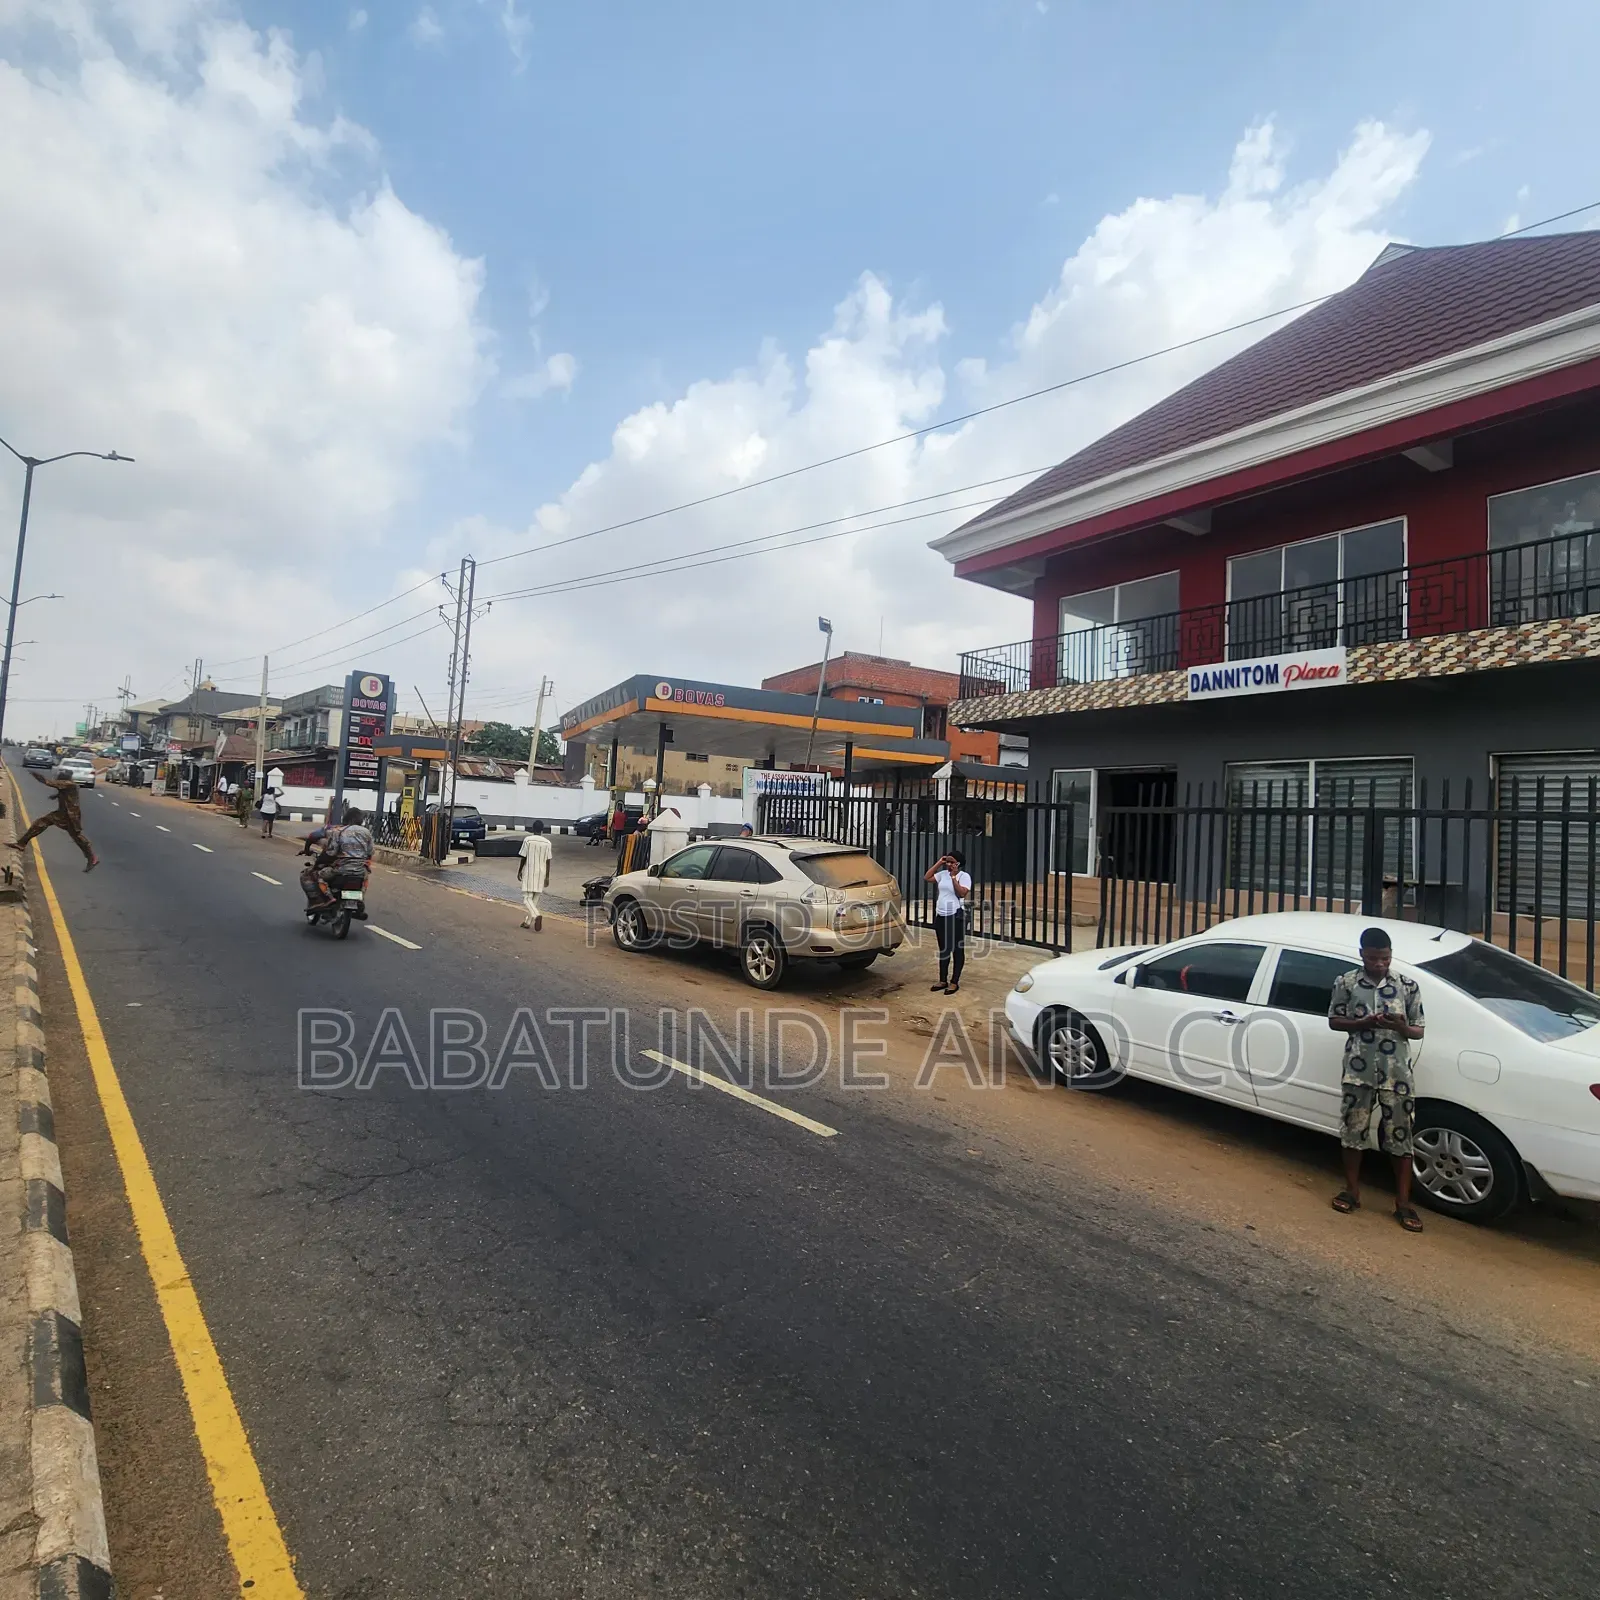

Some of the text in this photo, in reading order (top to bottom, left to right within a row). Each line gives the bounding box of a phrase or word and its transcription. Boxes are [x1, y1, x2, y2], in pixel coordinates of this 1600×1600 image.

[1191, 661, 1341, 692] DANNITOM Plaza
[370, 680, 378, 691] B
[352, 698, 387, 710] BOVAS
[662, 686, 724, 706] B BOVAS
